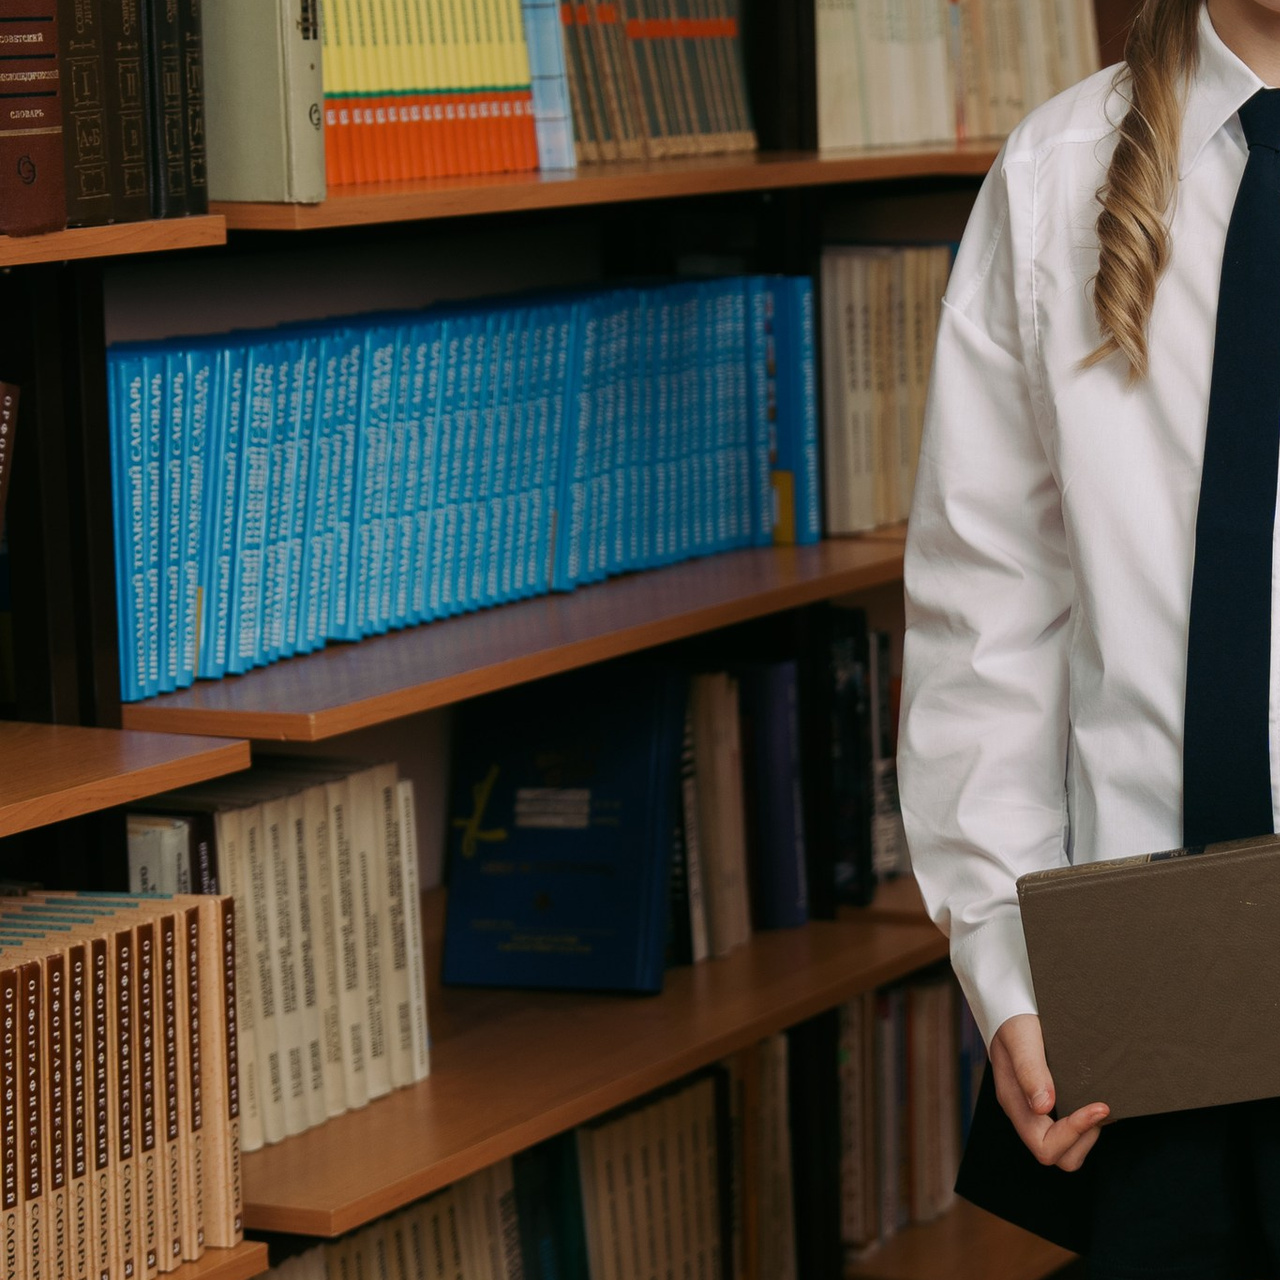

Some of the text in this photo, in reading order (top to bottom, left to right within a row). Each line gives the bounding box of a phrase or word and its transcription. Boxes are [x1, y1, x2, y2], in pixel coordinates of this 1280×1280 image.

[0, 32, 44, 44] СОВЕТСКИЙ
[9, 109, 45, 120] СЛОВАРЬ
[129, 376, 145, 687] ШКОЛЬНЫЙ ТОЛКОВЫЙ СЛОВАРЬ
[147, 373, 162, 681] ШКОЛЬНЫЙ ТОЛКОВЫЙ СЛОВАРЬ
[167, 372, 184, 677] ШКОЛЬНЫЙ ТОЛКОВЫЙ СЛОВАРЬ
[188, 455, 201, 555] ТОЛКОВЫЙ
[222, 451, 236, 550] ТОЛКОВЫЙ
[229, 368, 242, 448] СЛОВАРЬ
[184, 560, 197, 670] ШКОЛЬНЫЙ
[4, 987, 14, 1206] ОРФОГРАФИЧЕСКИЙ
[28, 978, 39, 1195] ОРФОГРАФИЧЕСКИЙ
[52, 971, 63, 1185] ОРФОГРАФИЧЕСКИЙ
[74, 961, 87, 1275] ОРФОГРАФИЧЕСКИЙ СЛОВАРЬ
[96, 954, 110, 1264] ОРФОГРАФИЧЕСКИЙ СЛОВАРЬ
[120, 946, 133, 1255] ОРФОГРАФИЧЕСКИЙ СЛОВАРЬ
[141, 939, 156, 1246] ОРФОГРАФИЧЕСКИЙ СЛОВАРЬ
[165, 930, 180, 1236] ОРФОГРАФИЧЕСКИЙ СЛОВАРЬ
[225, 913, 242, 1209] ОРФОГРАФИЧЕСКИЙ СЛОВАРЬ
